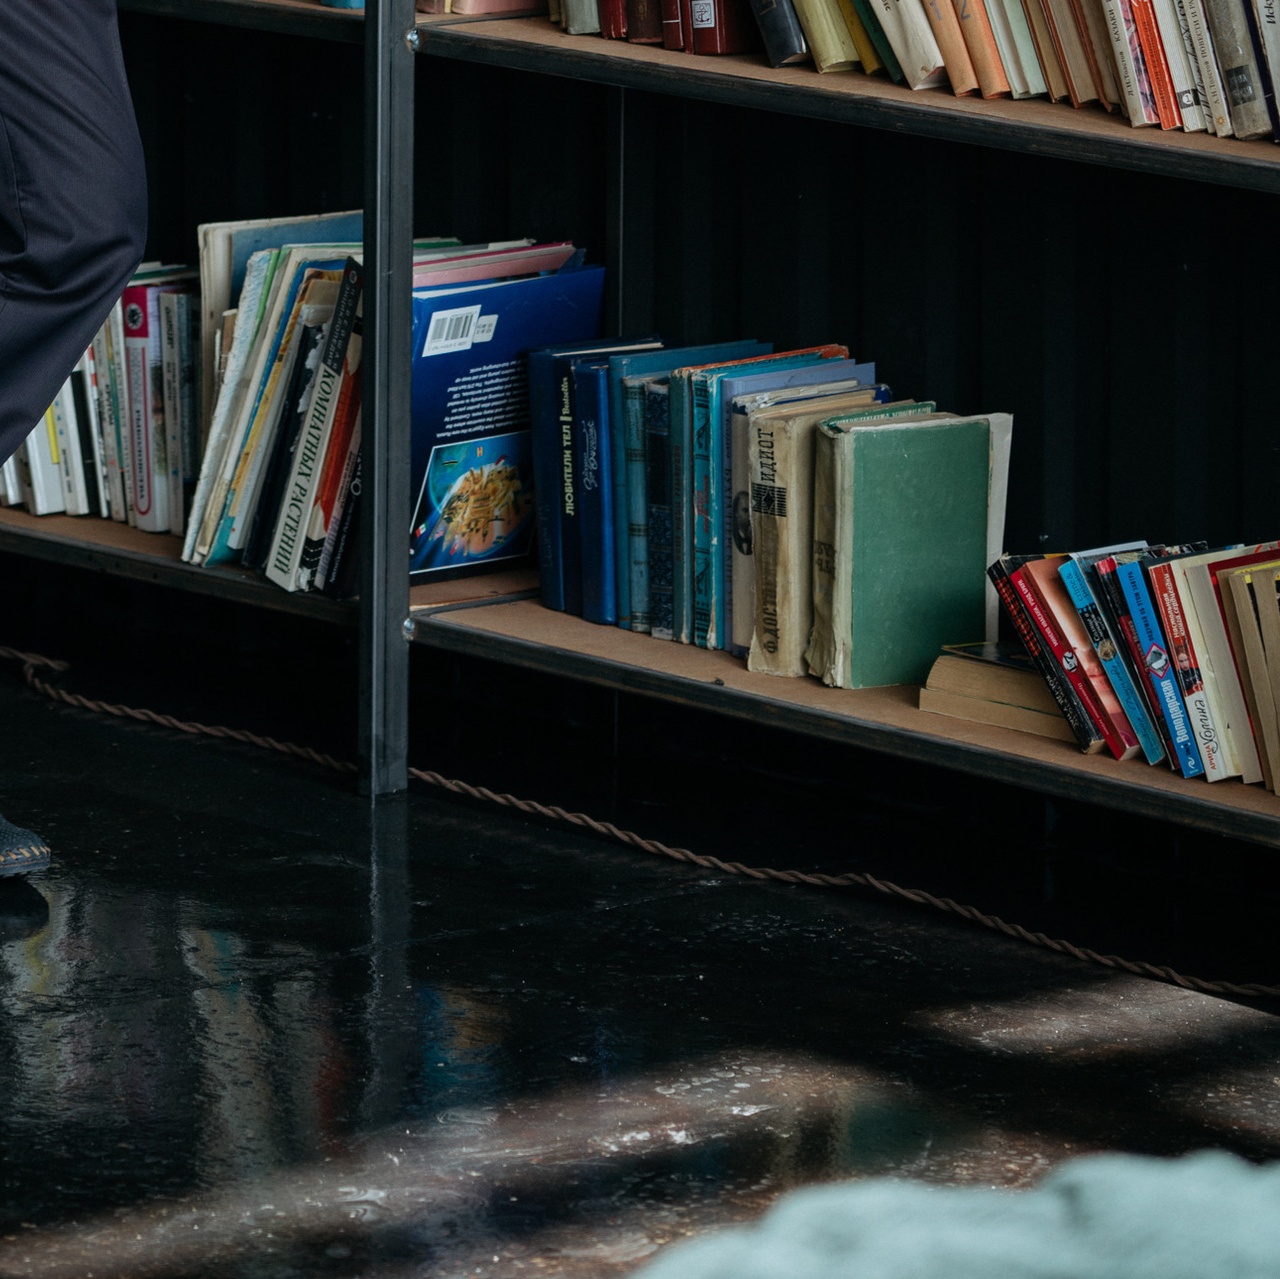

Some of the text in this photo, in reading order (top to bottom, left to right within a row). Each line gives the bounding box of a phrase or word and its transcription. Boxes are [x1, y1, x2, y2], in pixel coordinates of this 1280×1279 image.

[1109, 9, 1121, 42] КАЗАКИ
[1193, 19, 1208, 58] ПОВЕСТИ
[1119, 51, 1134, 96] Л.Н.Толстой
[561, 377, 576, 516] ЛЮБИТЕЛИ ТЕЛ Bestseller
[758, 428, 776, 482] ИДИОТ
[273, 368, 336, 576] КОМНАТНЫХ РАСТЕНИЙ
[1127, 571, 1139, 591] ЗАВТРА
[1133, 592, 1144, 606] ЭТОМ
[1162, 593, 1179, 637] Настольная
[1164, 573, 1186, 636] книга сердцеедки
[1143, 615, 1154, 641] ПОДУМАЙ
[1161, 680, 1189, 742] Володарская
[1195, 699, 1218, 770] АРИНА Холина
